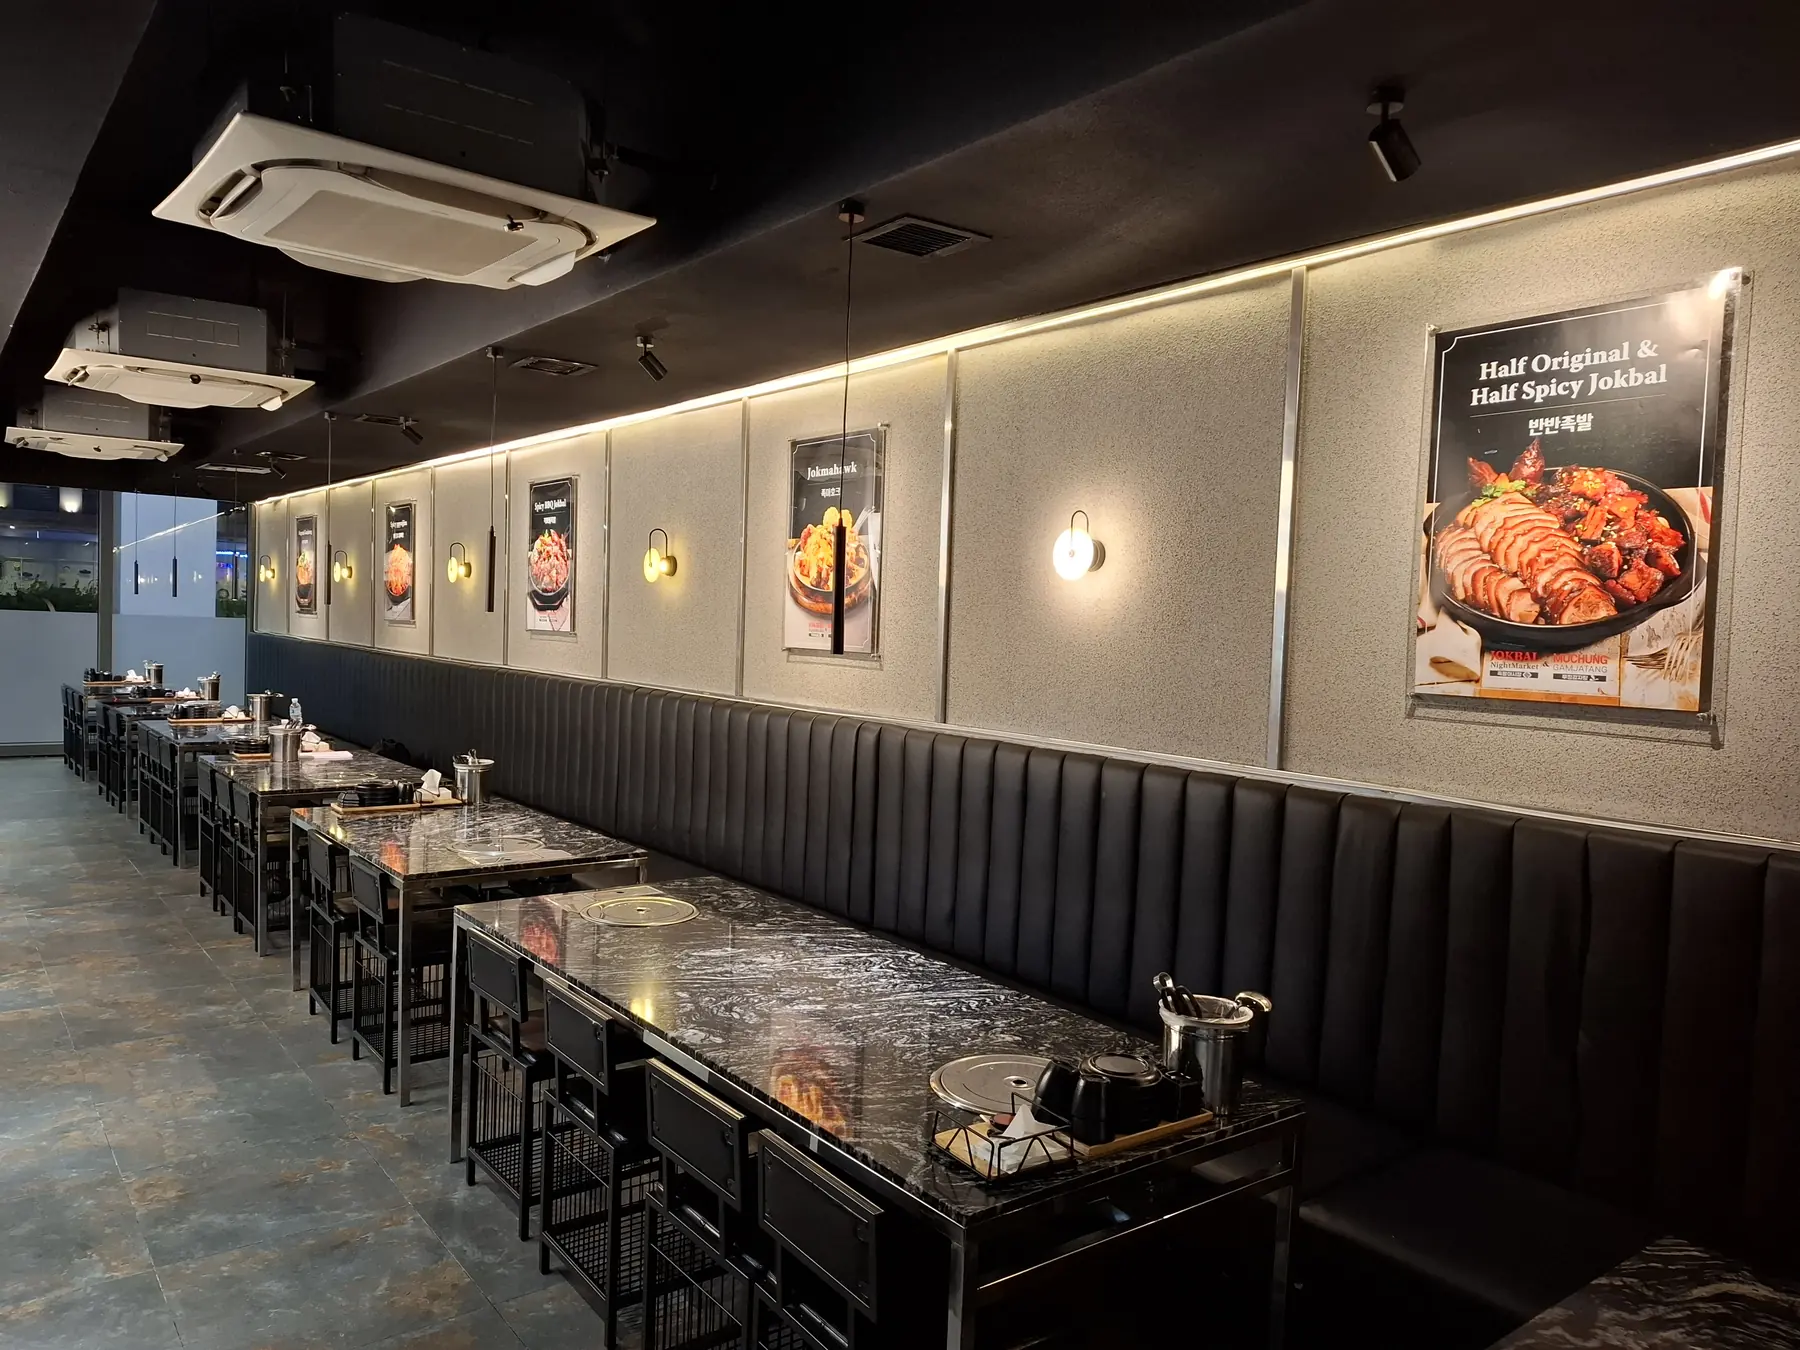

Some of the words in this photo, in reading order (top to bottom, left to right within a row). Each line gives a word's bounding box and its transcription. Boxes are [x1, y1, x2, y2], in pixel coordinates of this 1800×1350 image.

[1479, 356, 1528, 381] Half
[1531, 341, 1630, 373] Original
[1637, 339, 1659, 359] &
[1470, 383, 1519, 406] Half
[1521, 377, 1584, 403] Spicy
[1587, 364, 1667, 396] Jokbal
[1528, 412, 1594, 437] 반반족발
[1490, 661, 1539, 670] NightMarket
[1553, 653, 1608, 665] MUCHUNG
[1553, 663, 1608, 673] GAMJATANG
